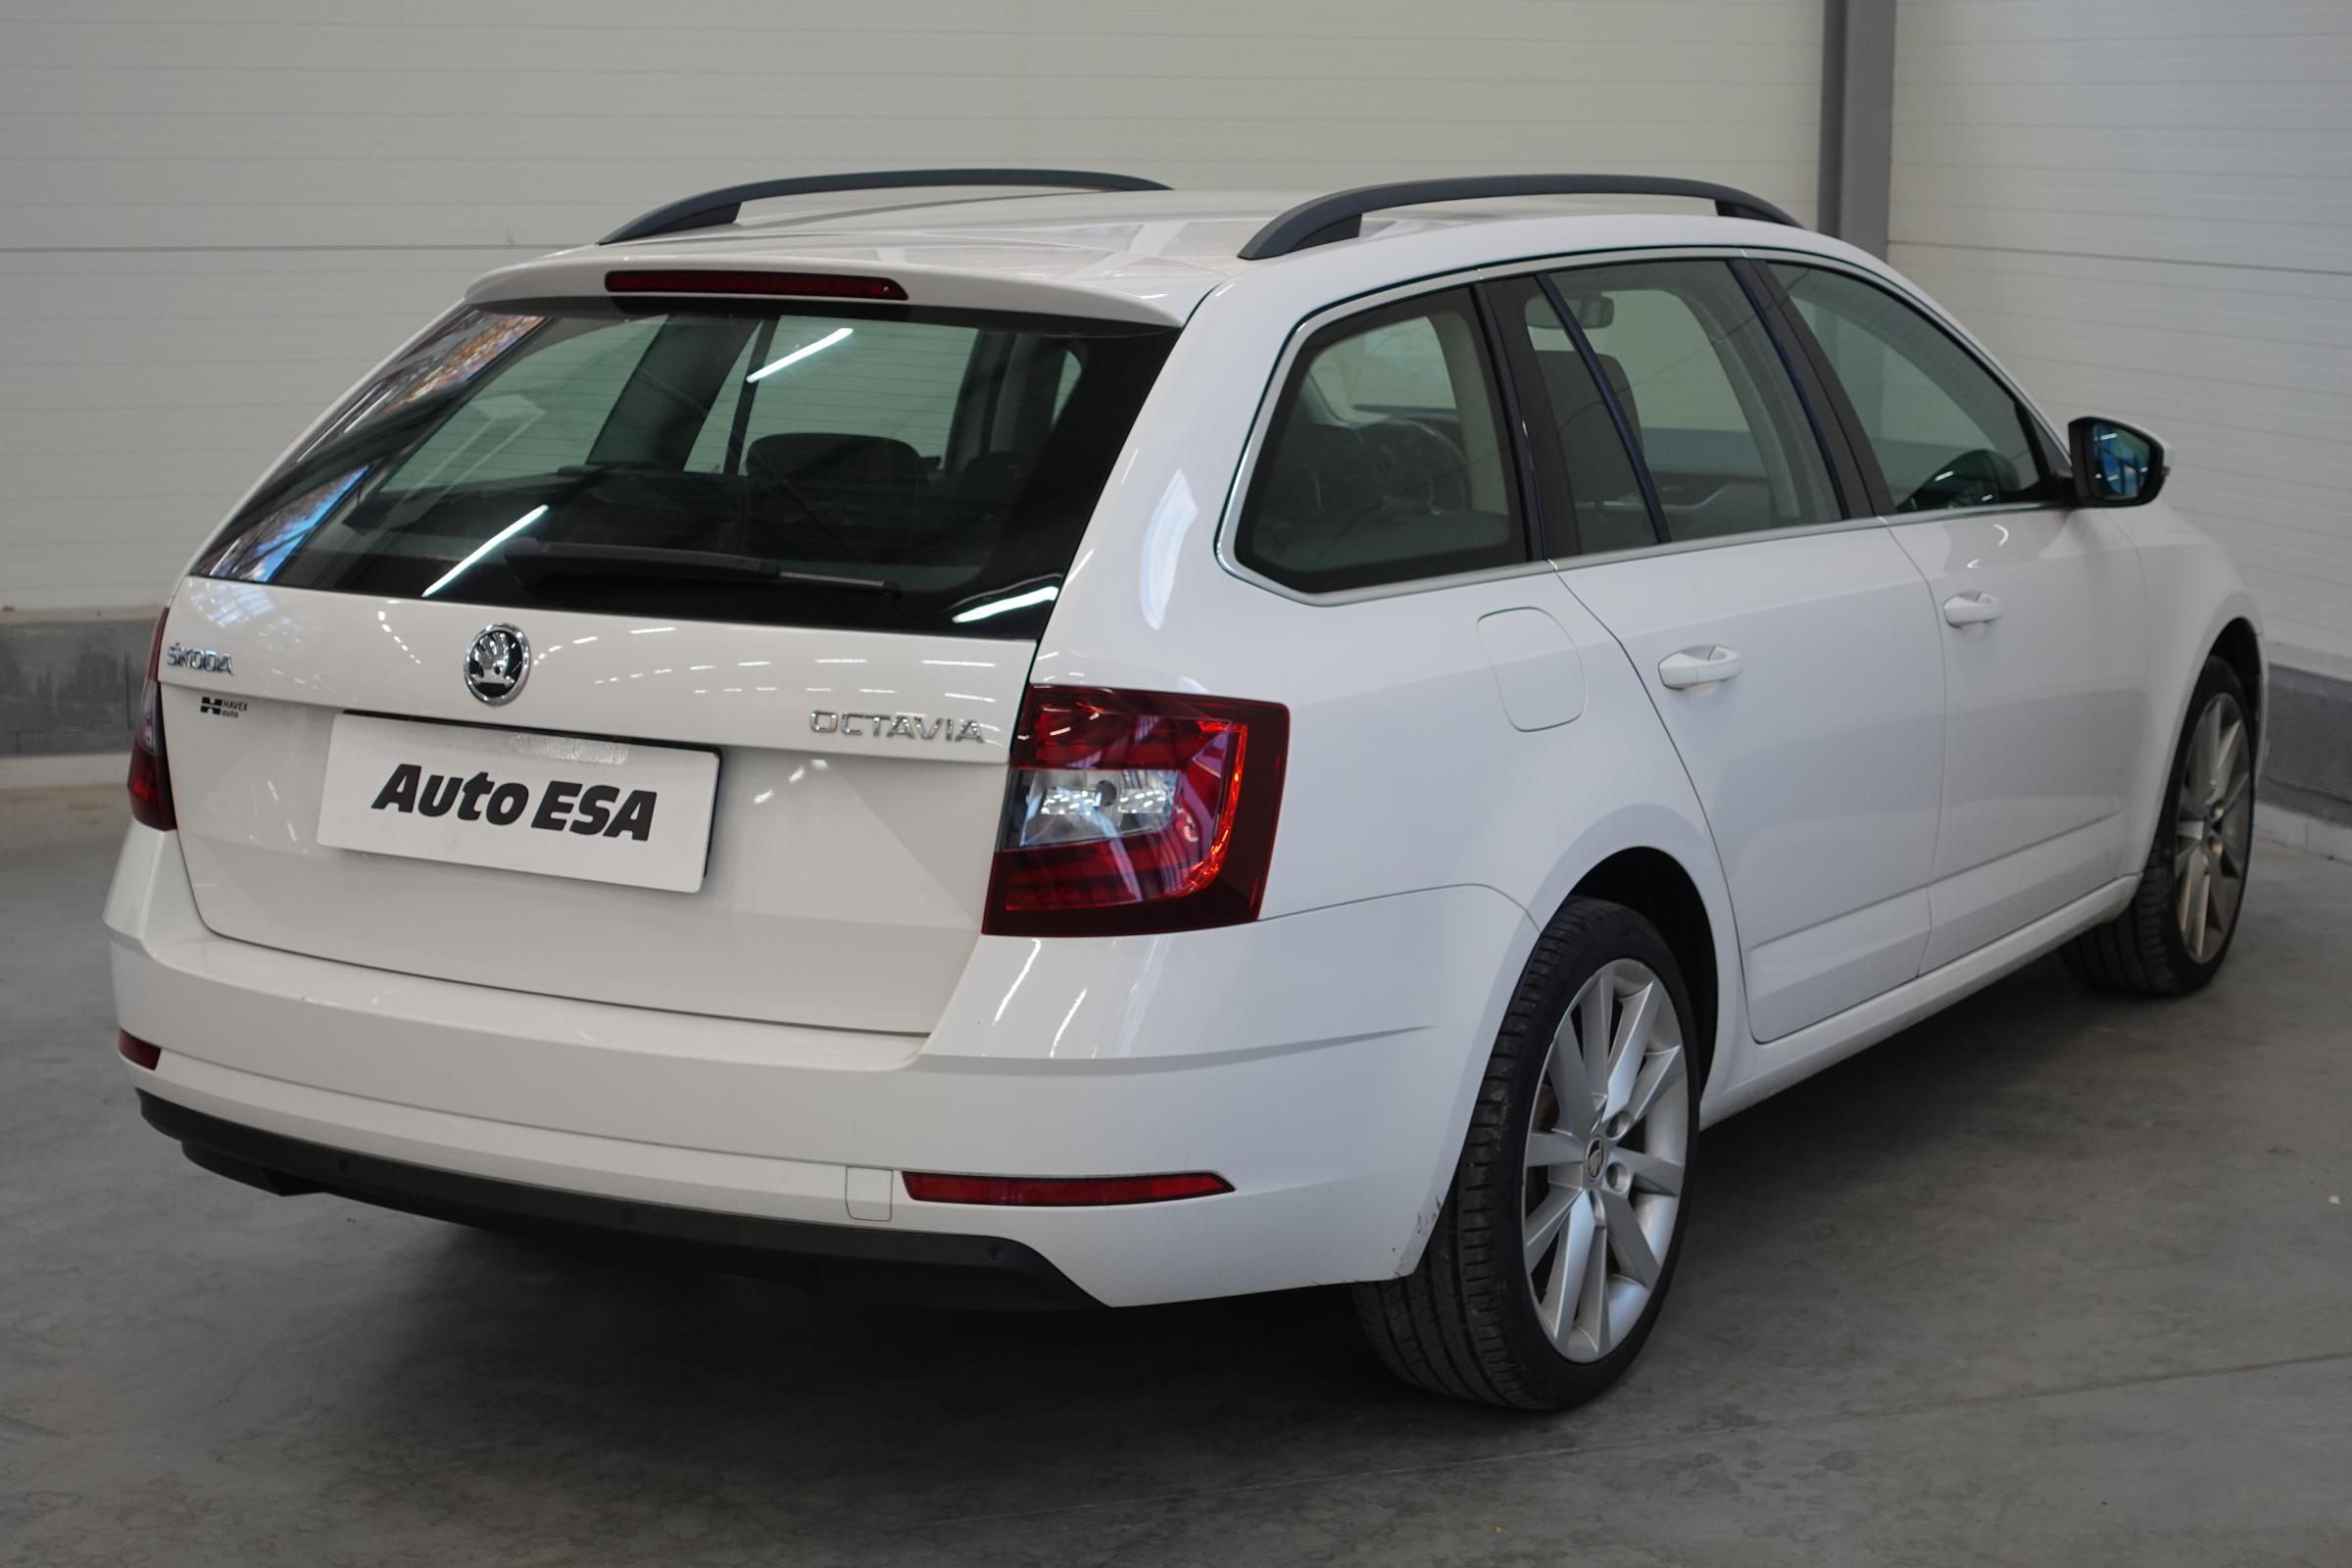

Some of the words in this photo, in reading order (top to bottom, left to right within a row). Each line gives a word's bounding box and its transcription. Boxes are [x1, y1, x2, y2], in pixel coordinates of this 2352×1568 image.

[167, 642, 234, 676] ŠKODA
[220, 710, 238, 718] auto
[809, 710, 985, 744] OCTAVIA
[370, 763, 529, 826] Auto
[530, 780, 658, 842] ESA
